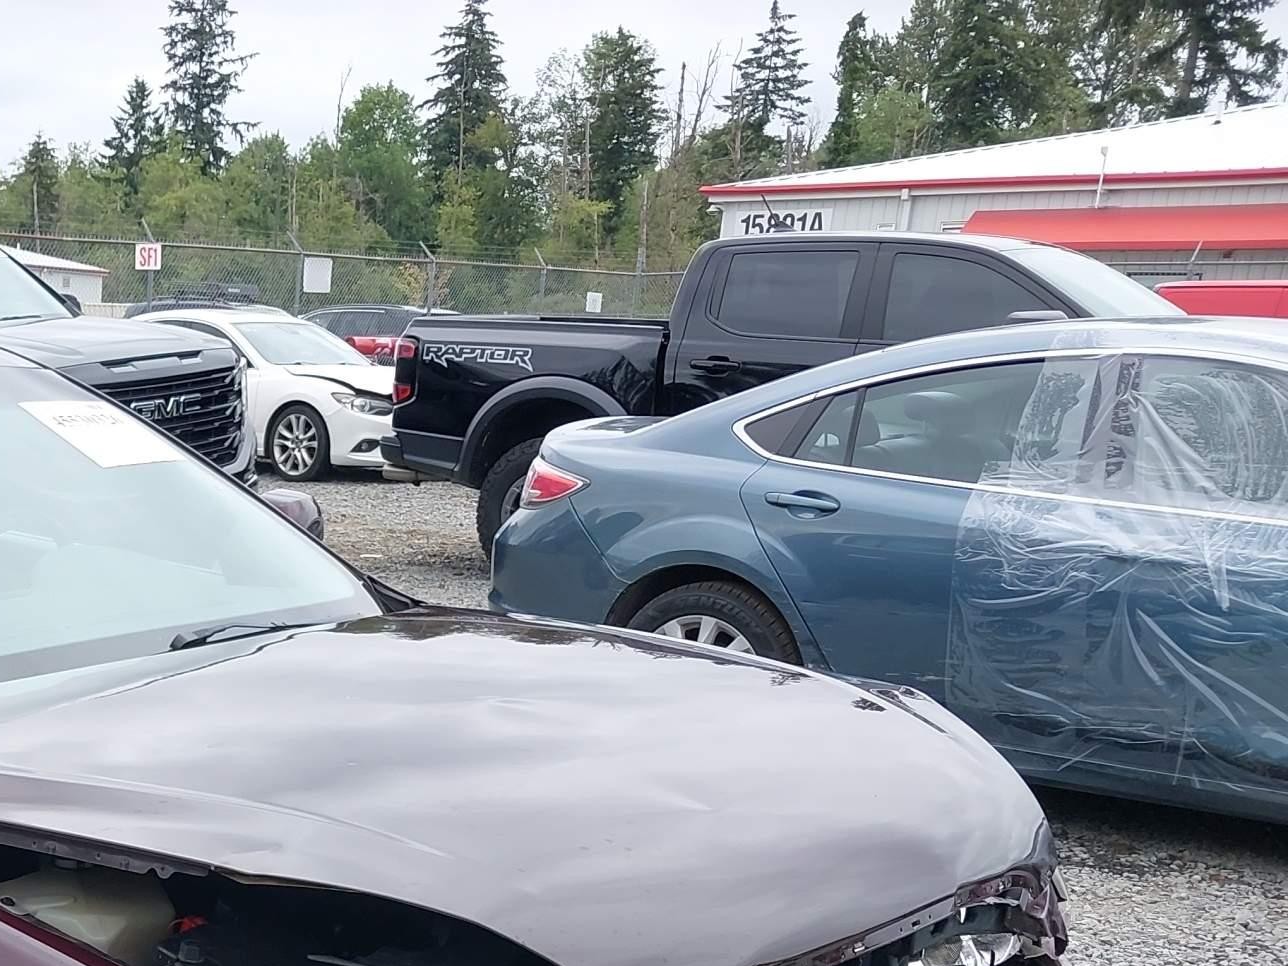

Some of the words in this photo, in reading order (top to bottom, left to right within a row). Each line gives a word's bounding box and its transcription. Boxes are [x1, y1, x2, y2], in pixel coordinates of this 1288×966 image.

[140, 246, 158, 267] SF1
[422, 343, 534, 373] RAPTOR
[130, 393, 201, 420] GMC
